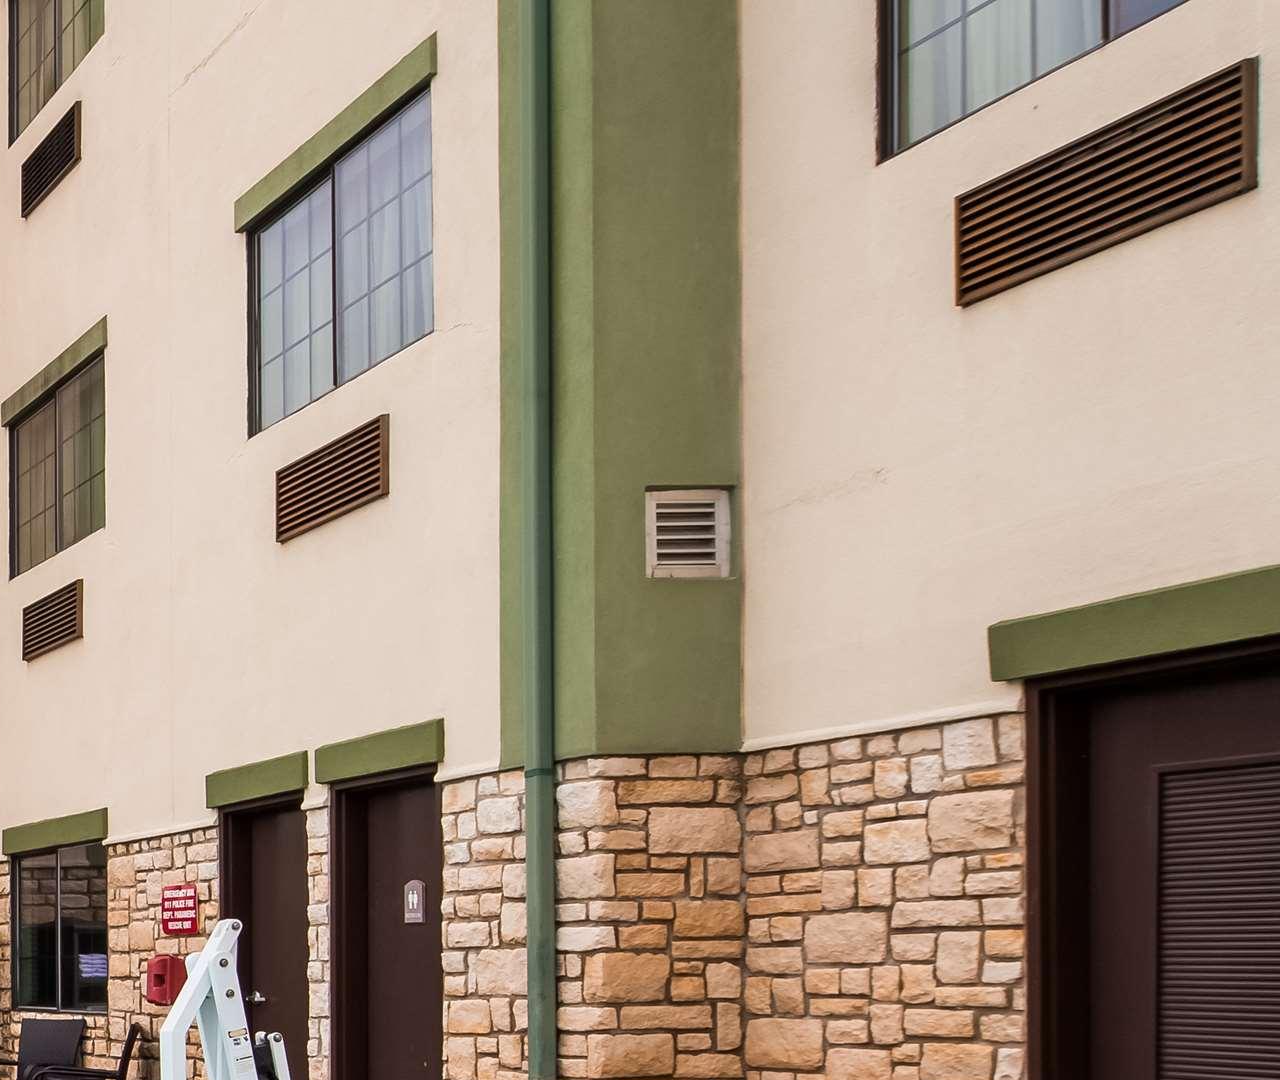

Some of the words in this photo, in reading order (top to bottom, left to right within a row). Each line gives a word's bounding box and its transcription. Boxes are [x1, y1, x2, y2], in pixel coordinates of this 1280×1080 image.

[164, 890, 186, 898] EMERGENCY
[172, 900, 185, 908] POLICE
[186, 899, 194, 907] FIRE
